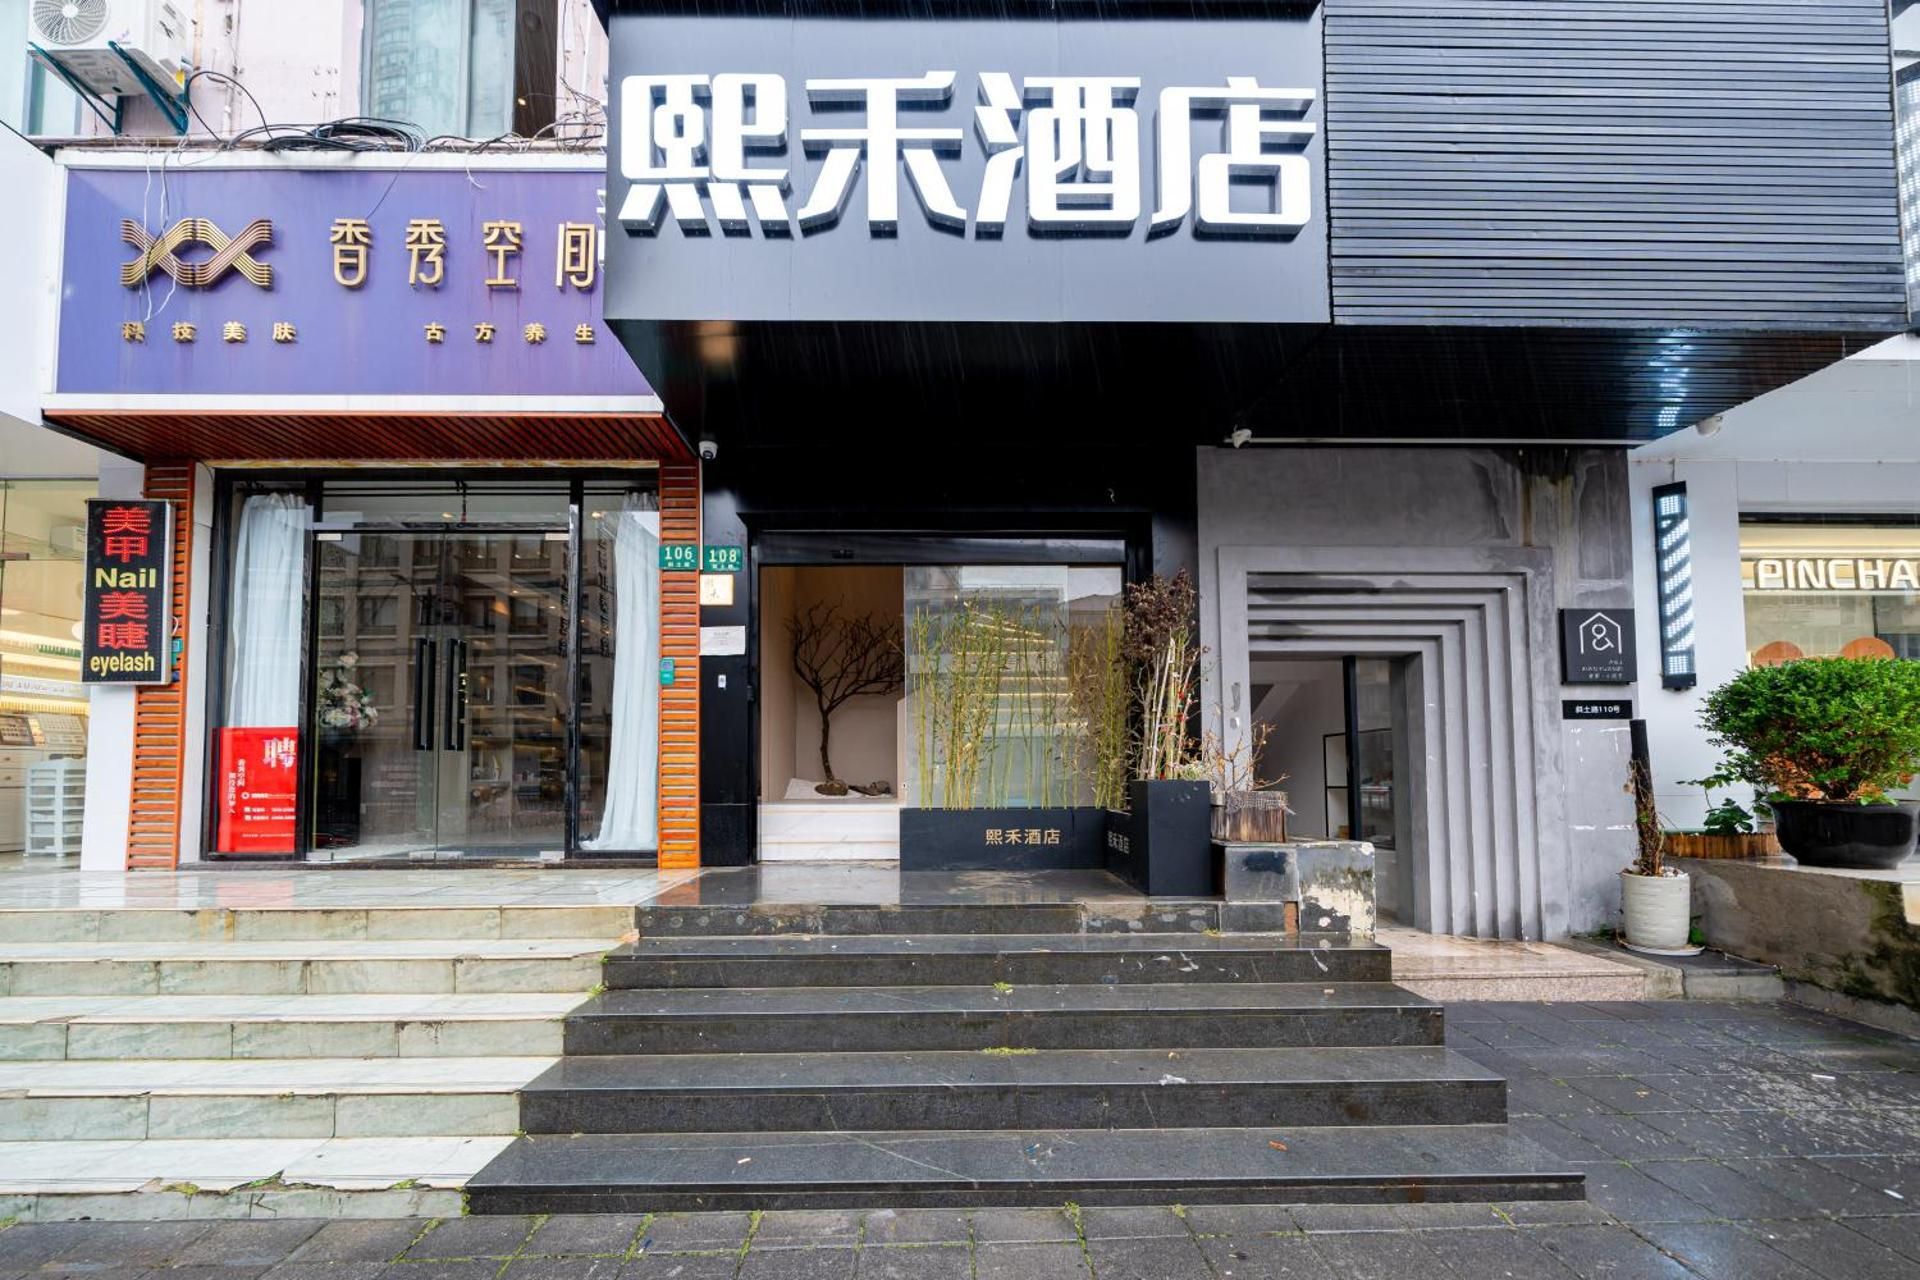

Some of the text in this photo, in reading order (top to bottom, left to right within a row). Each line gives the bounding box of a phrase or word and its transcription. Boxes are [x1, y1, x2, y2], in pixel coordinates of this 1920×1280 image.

[618, 71, 1318, 242] 熙禾酒店
[331, 218, 596, 288] 香秀空间
[424, 322, 596, 345] 古方养生
[103, 506, 151, 563] 美甲
[665, 547, 692, 560] 106
[709, 549, 737, 563] 108
[95, 568, 157, 588] Nail
[98, 591, 149, 649] 美睫
[90, 652, 155, 677] eyelash
[263, 737, 296, 769] 聘
[985, 828, 1061, 846] 熙禾酒店
